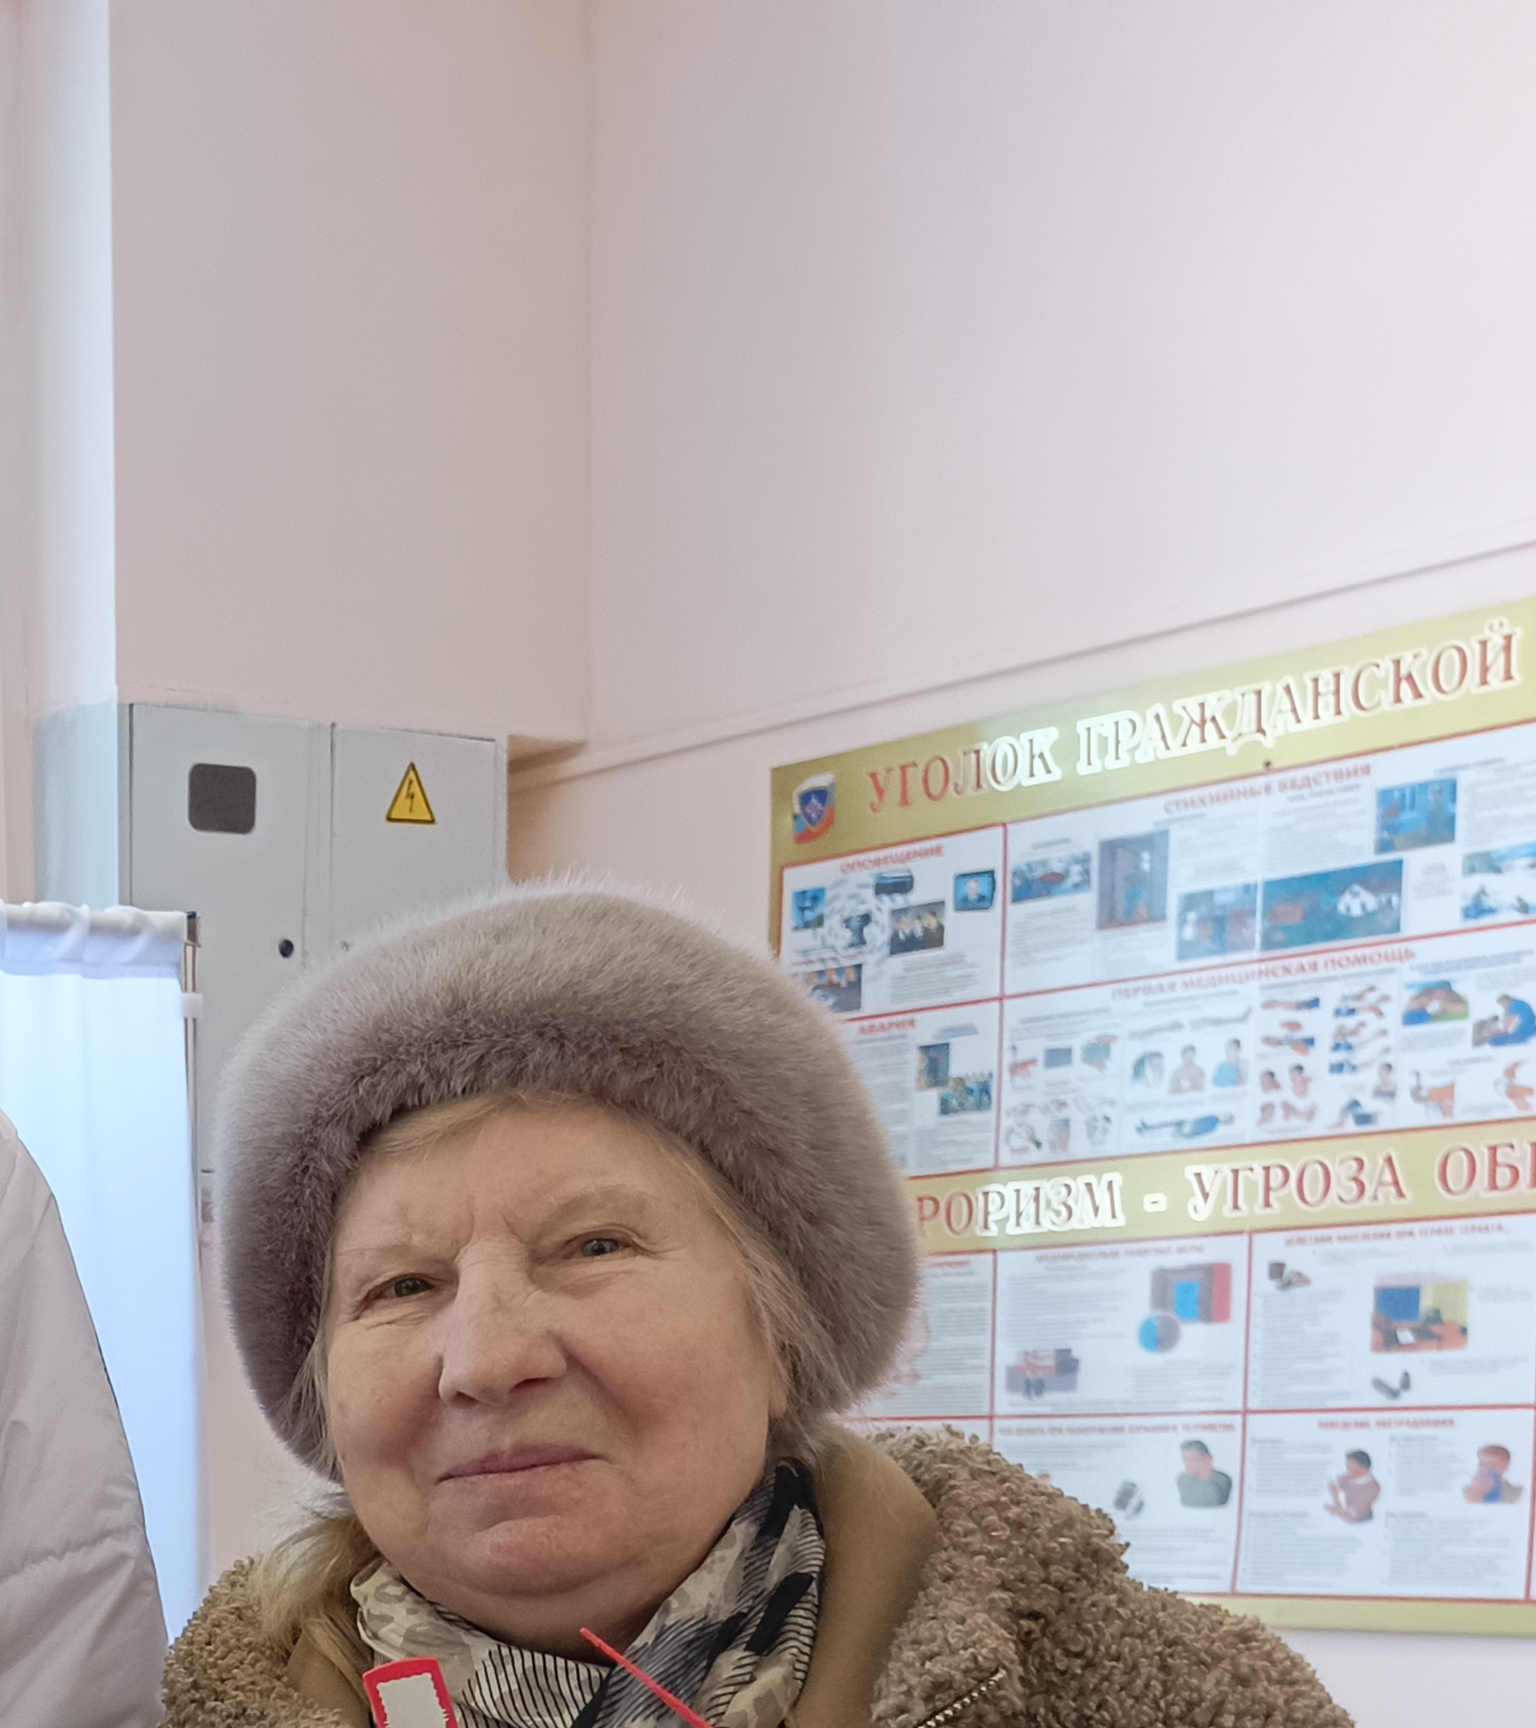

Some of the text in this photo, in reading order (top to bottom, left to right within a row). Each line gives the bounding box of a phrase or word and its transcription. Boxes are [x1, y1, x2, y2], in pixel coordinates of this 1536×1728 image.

[867, 620, 1521, 814] УГОЛОК ГРАЖДАНСКОЙ
[1187, 1147, 1409, 1221] УГРОЗА
[1436, 1139, 1536, 1197] ОБ
